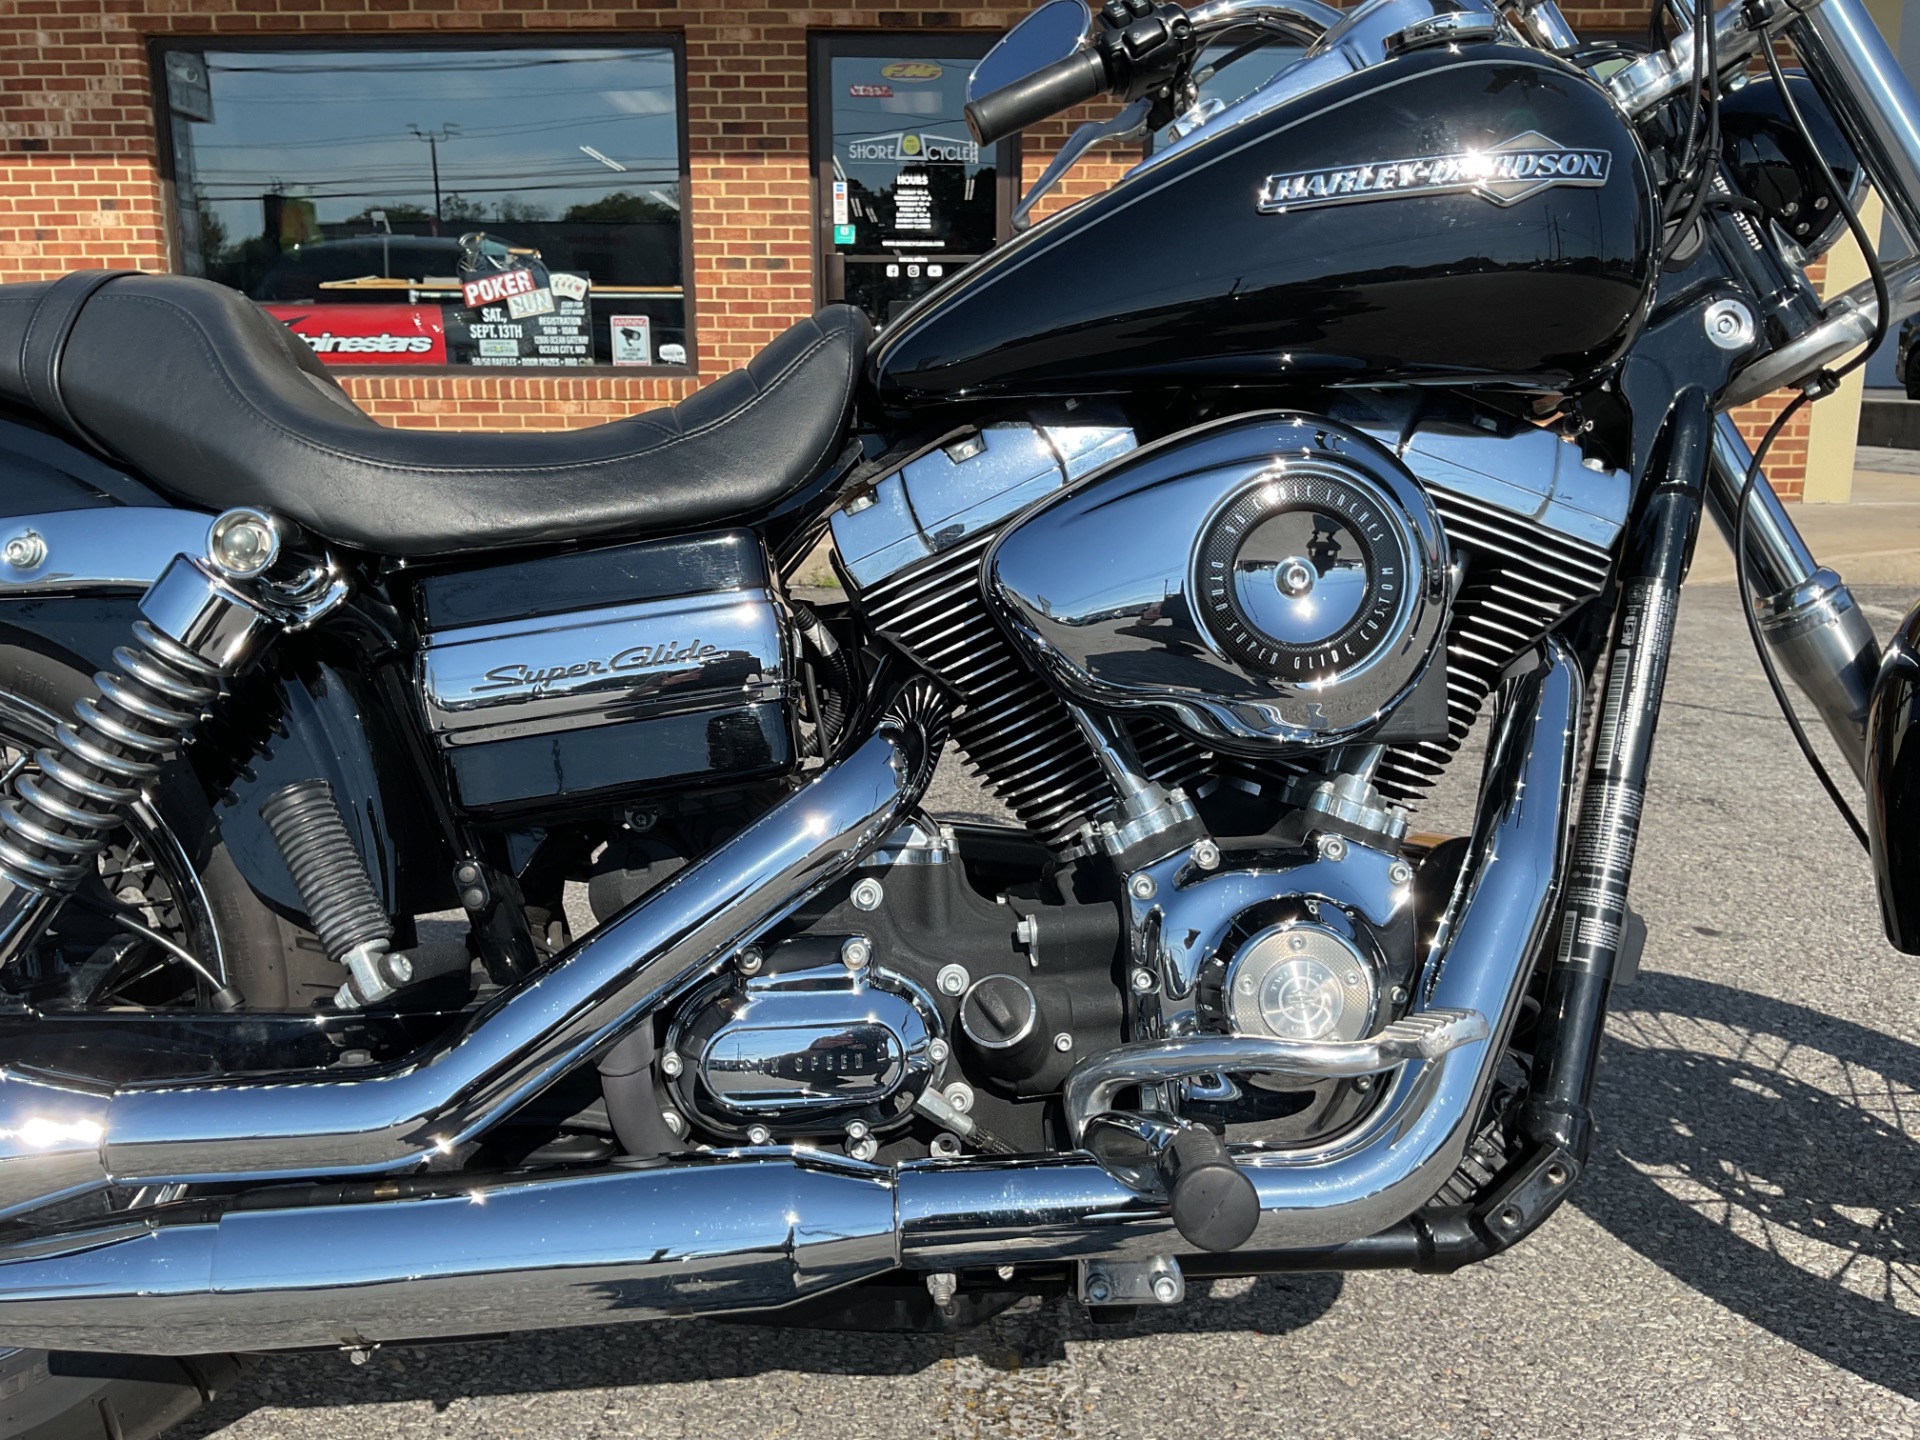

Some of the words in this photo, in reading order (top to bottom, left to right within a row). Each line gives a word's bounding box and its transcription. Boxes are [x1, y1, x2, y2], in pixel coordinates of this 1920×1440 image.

[848, 145, 895, 159] SHORE
[897, 175, 929, 185] HOURS
[465, 271, 532, 305] POKER
[510, 290, 550, 316] RUN
[538, 317, 581, 326] REGISTRATION
[469, 325, 498, 339] SEPT.
[498, 324, 523, 338] 13TH
[543, 327, 557, 335] 9AM
[561, 327, 579, 335] 10AM
[297, 333, 433, 352] pinestars
[566, 336, 589, 344] GATEWAY
[538, 346, 559, 354] OCEAN
[560, 346, 575, 354] CITY,
[575, 346, 586, 354] MD
[471, 358, 491, 366] 50/50
[492, 358, 517, 366] RAFFLES
[539, 358, 560, 366] PRIZES
[1253, 485, 1311, 509] CBIC
[1326, 489, 1384, 542] INCHES
[1210, 560, 1229, 612] DYNA
[1226, 622, 1278, 665] SUPER
[1293, 643, 1356, 670] GLIDE
[1360, 567, 1394, 641] CUSTOM
[470, 660, 608, 692] Super
[609, 639, 729, 672] Glide
[795, 1052, 864, 1073] SPEED
